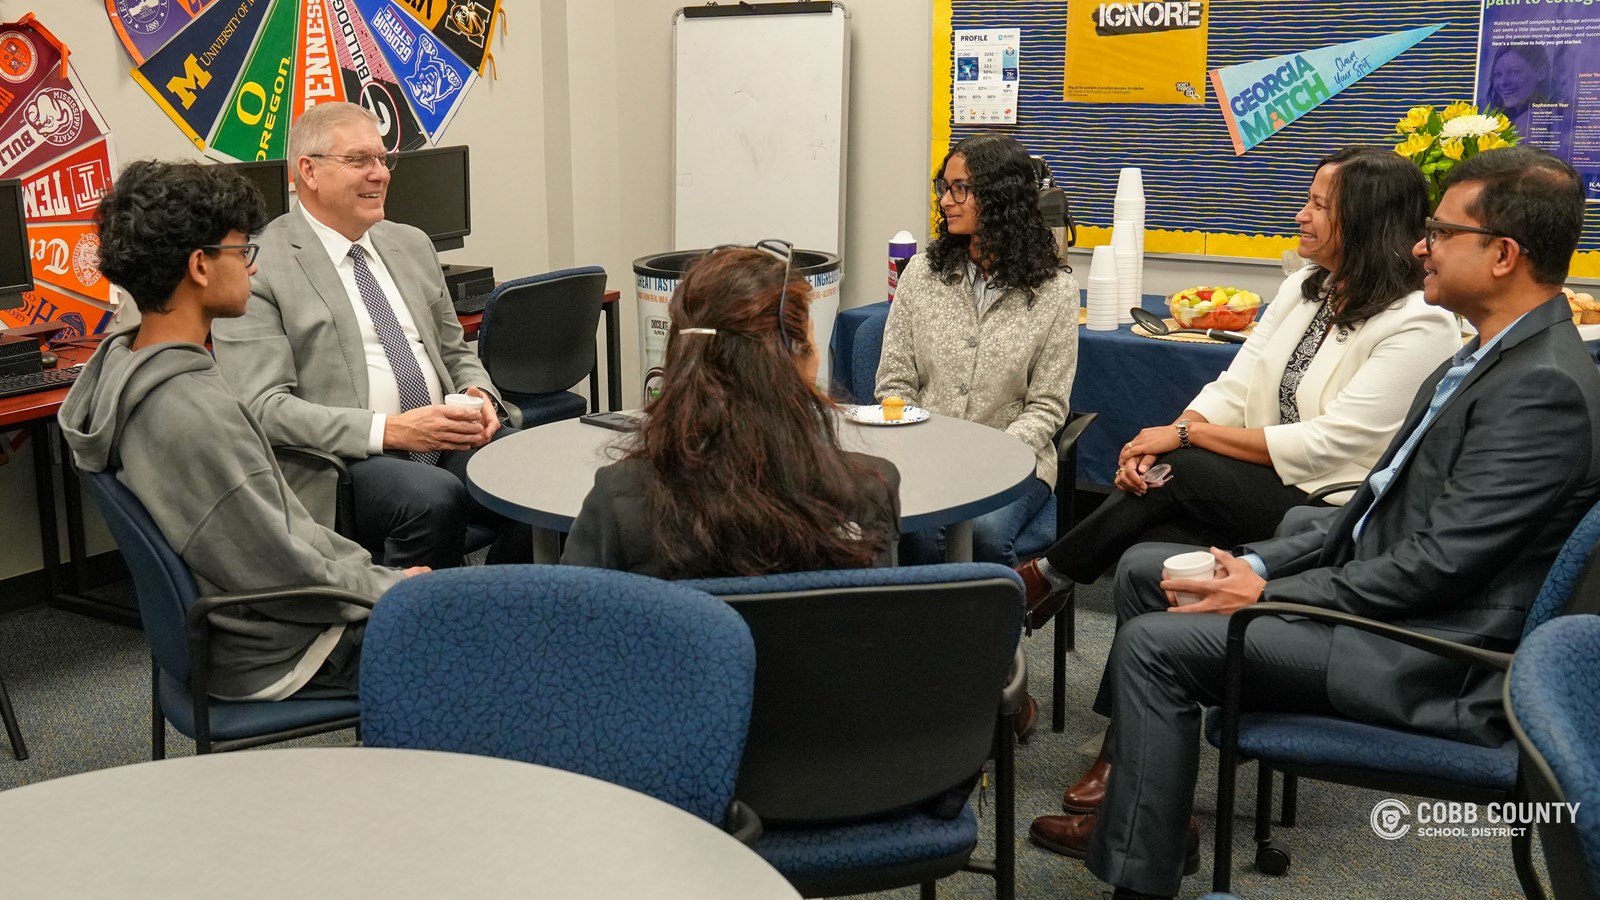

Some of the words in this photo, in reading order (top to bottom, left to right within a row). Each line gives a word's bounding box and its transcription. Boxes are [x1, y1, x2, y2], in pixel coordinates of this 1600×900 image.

[146, 20, 160, 32] 1889
[386, 8, 415, 46] STATE
[1099, 2, 1201, 27] IGNORE
[200, 14, 241, 67] UNIVERSITY
[238, 2, 249, 18] OF
[371, 11, 413, 63] GEORGIA
[304, 0, 336, 110] ENNES
[1335, 50, 1358, 73] Claim
[166, 53, 213, 111] M
[1230, 54, 1315, 117] GEORGIA
[1334, 69, 1352, 89] Your
[53, 91, 80, 130] MISSISSIPPI
[236, 81, 267, 126] O
[1238, 72, 1331, 144] MATCH
[53, 129, 76, 143] STATE
[651, 319, 669, 331] CHOCOLATE
